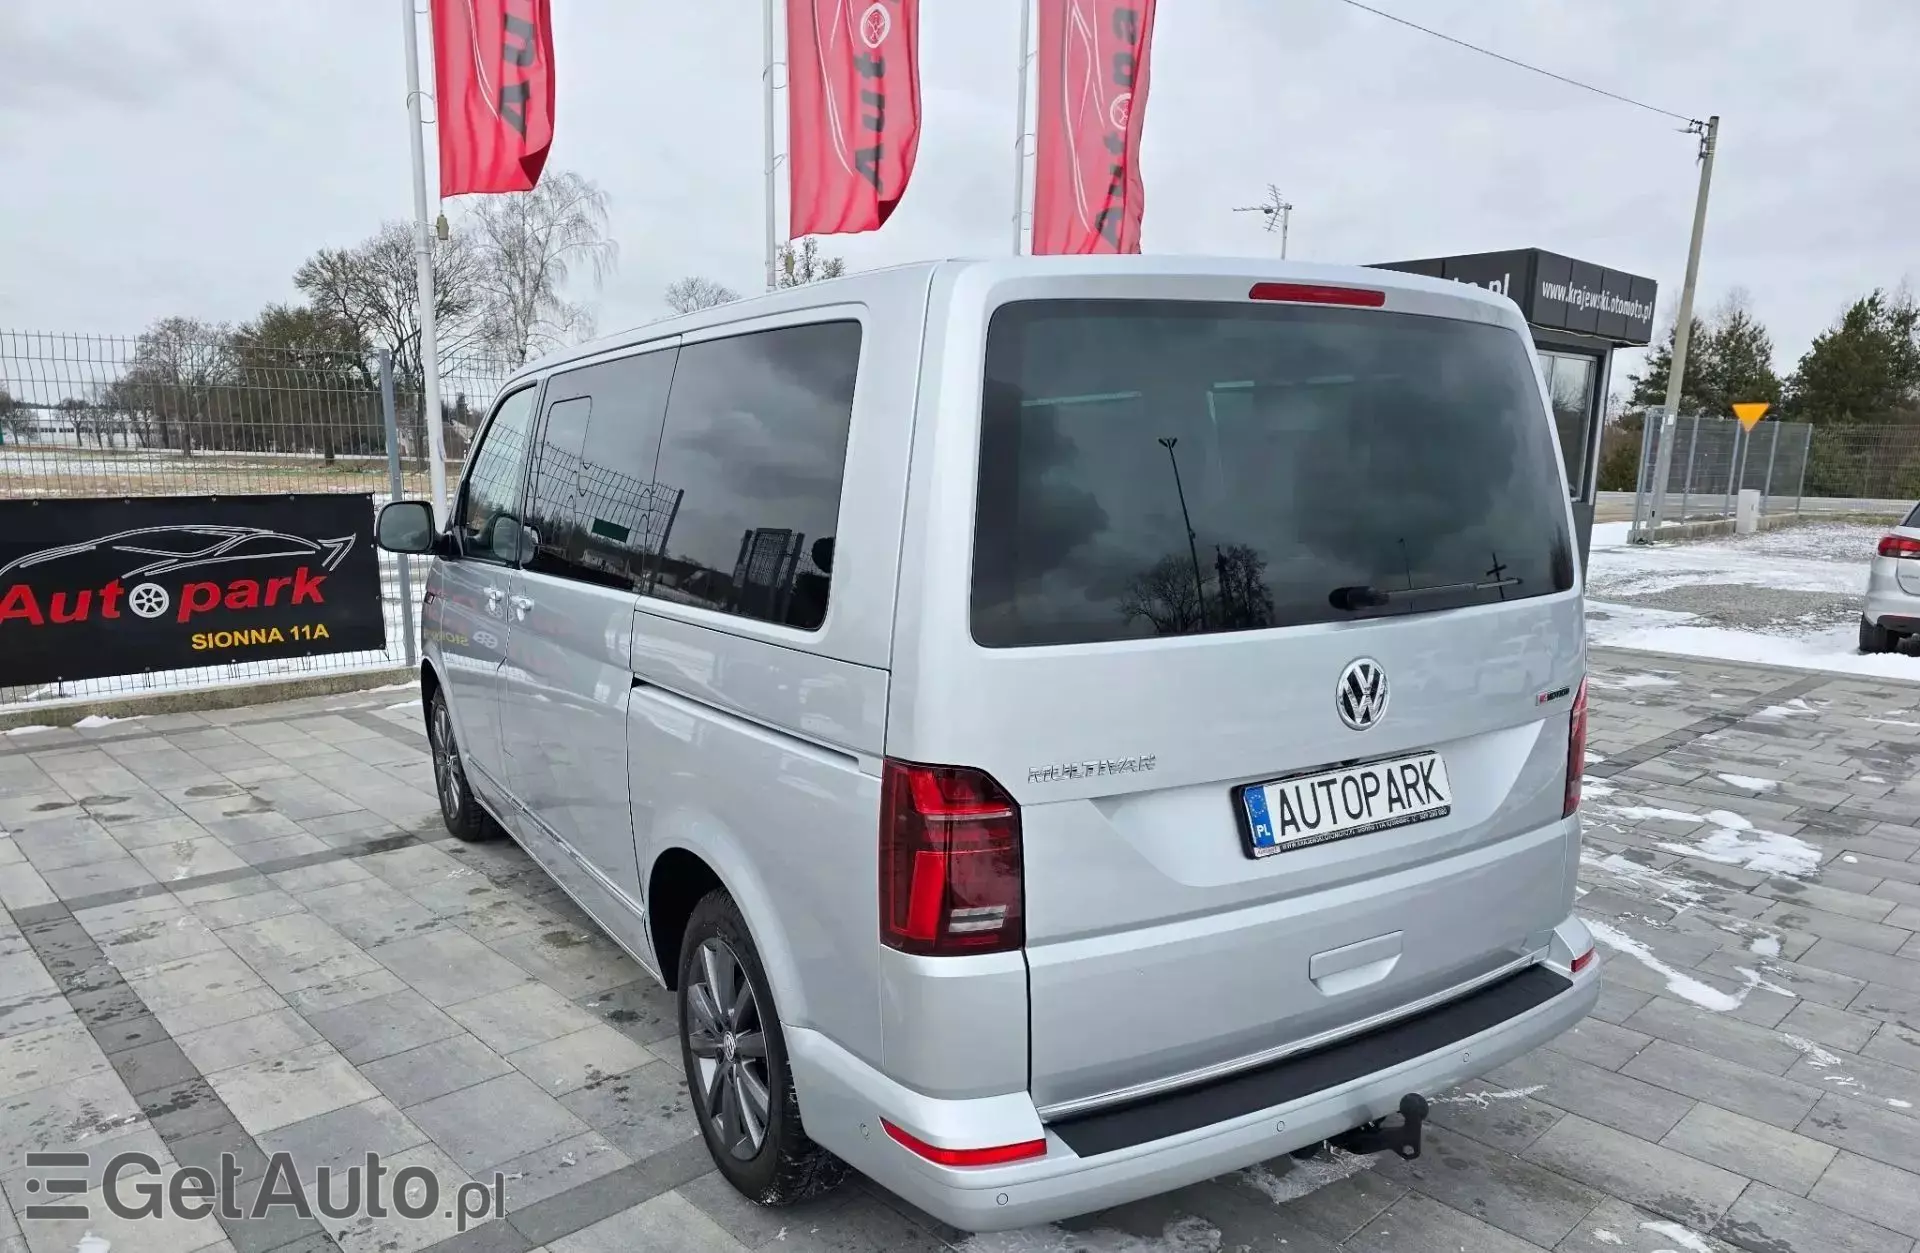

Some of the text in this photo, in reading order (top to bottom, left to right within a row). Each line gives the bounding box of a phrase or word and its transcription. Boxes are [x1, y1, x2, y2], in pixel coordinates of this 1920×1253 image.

[1542, 281, 1652, 324] www.krajewski.otomoto.pl
[191, 623, 330, 651] SIONNA 11A
[1279, 757, 1445, 837] AUTOPARK
[1256, 824, 1271, 838] PL
